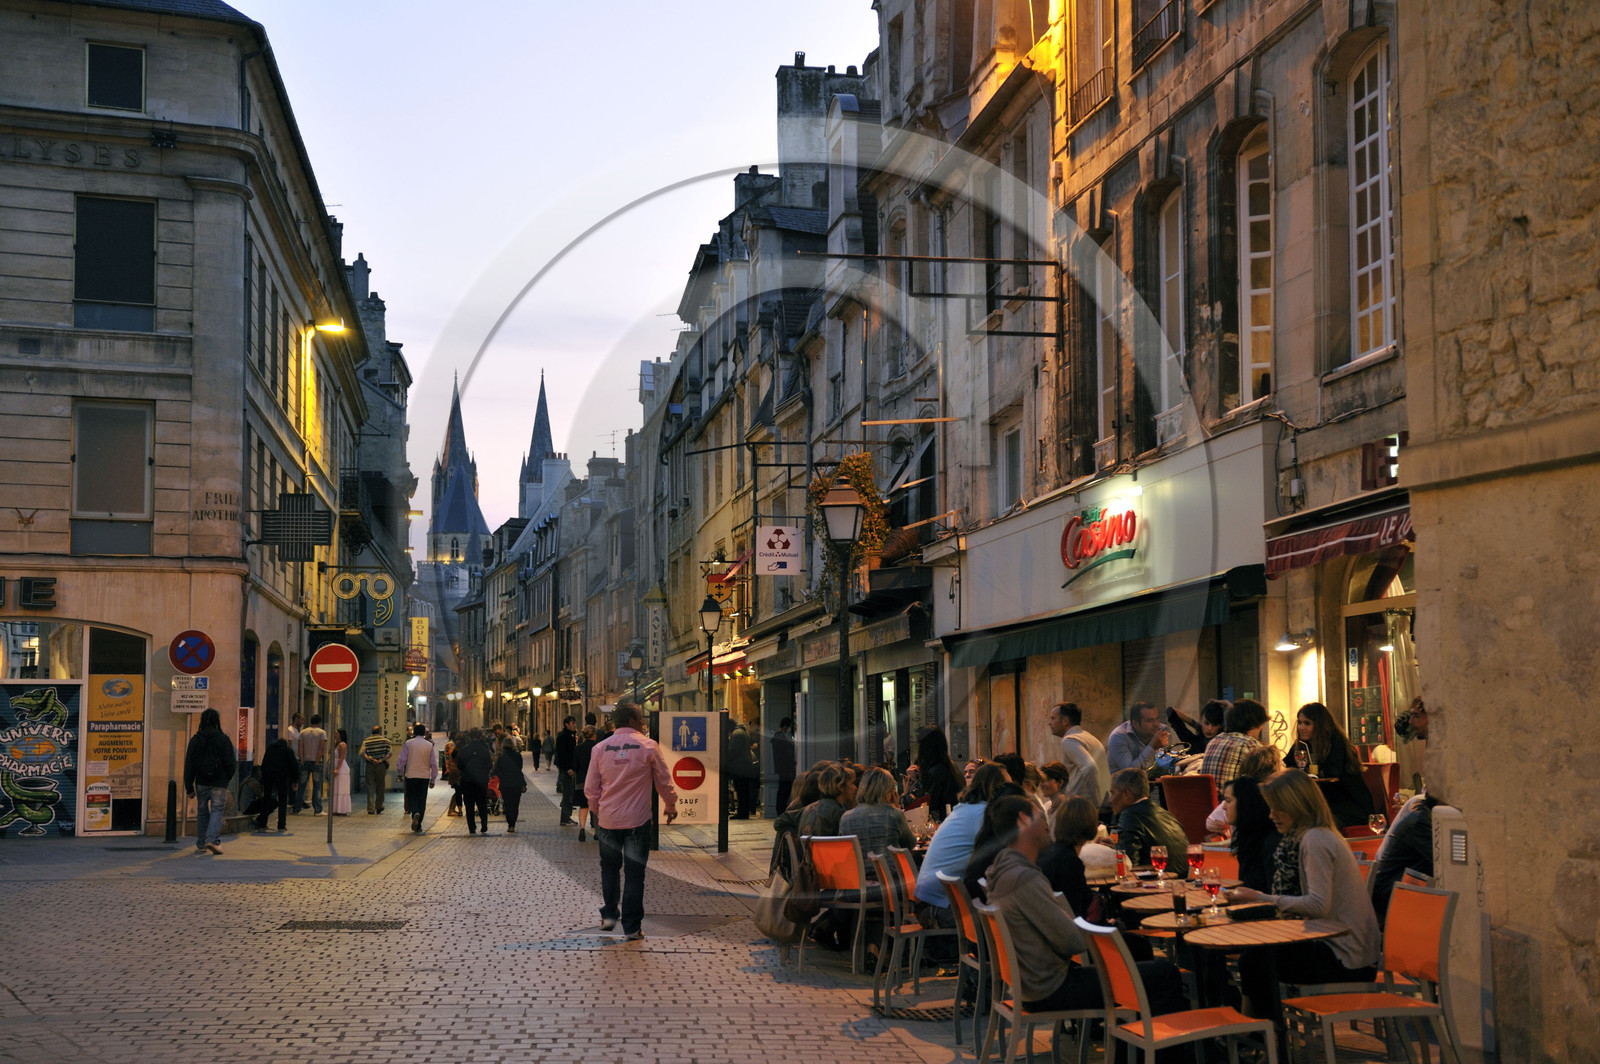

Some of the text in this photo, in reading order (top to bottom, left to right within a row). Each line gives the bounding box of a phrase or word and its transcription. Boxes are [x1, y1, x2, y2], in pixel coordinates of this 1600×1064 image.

[0, 137, 140, 168] LYSES
[1061, 508, 1136, 569] Casino
[1380, 515, 1398, 545] LE
[652, 609, 660, 662] LAVERIE
[90, 722, 141, 732] Parapharmacie
